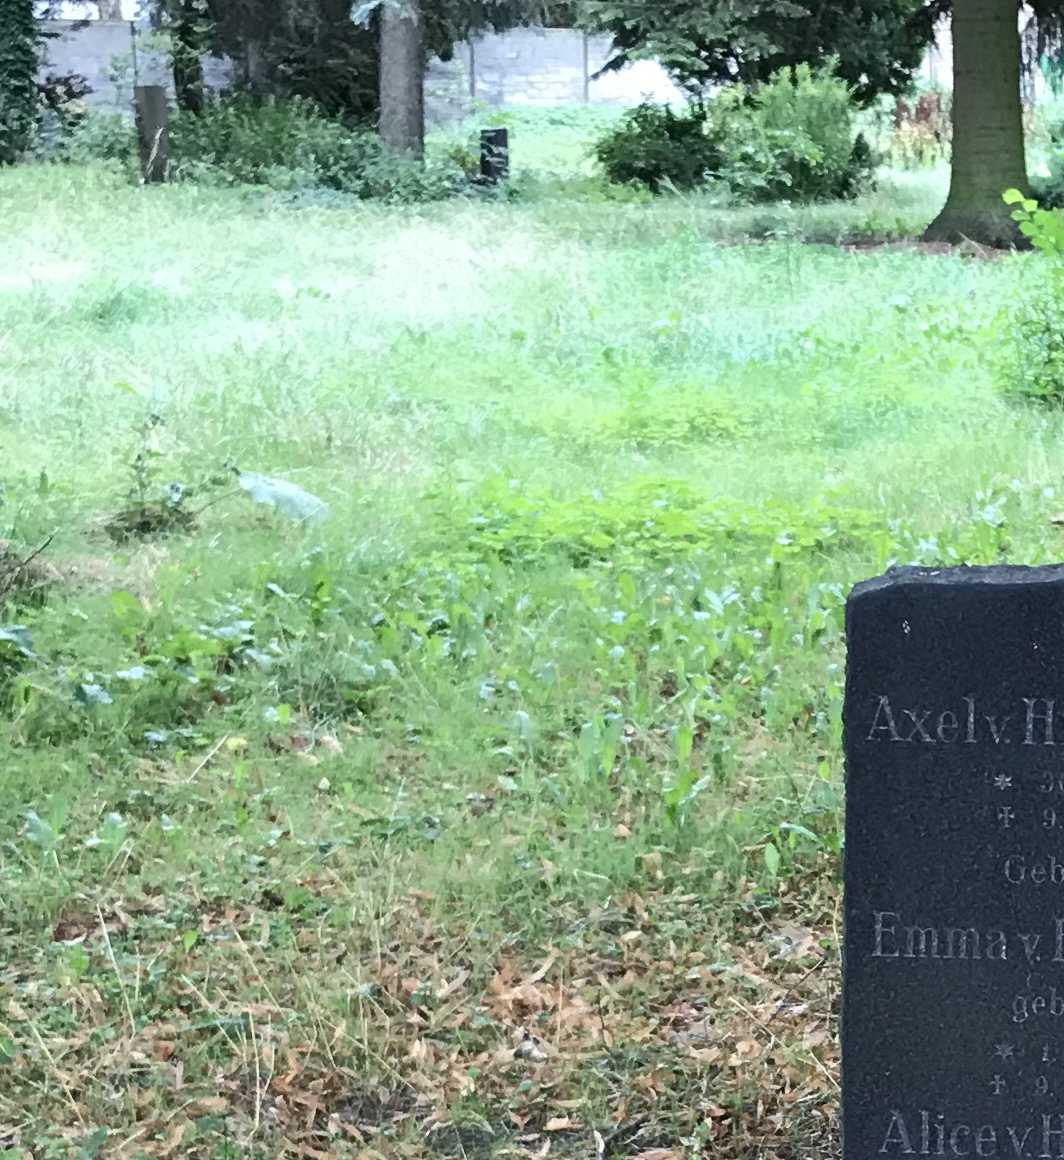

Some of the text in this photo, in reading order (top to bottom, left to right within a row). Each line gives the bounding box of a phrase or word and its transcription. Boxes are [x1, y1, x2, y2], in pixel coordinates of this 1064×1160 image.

[864, 694, 977, 744] Axel
[870, 911, 1008, 961] Emma
[1019, 934, 1042, 965] v.
[878, 1109, 996, 1156] Alice
[1006, 1126, 1032, 1158] v.
